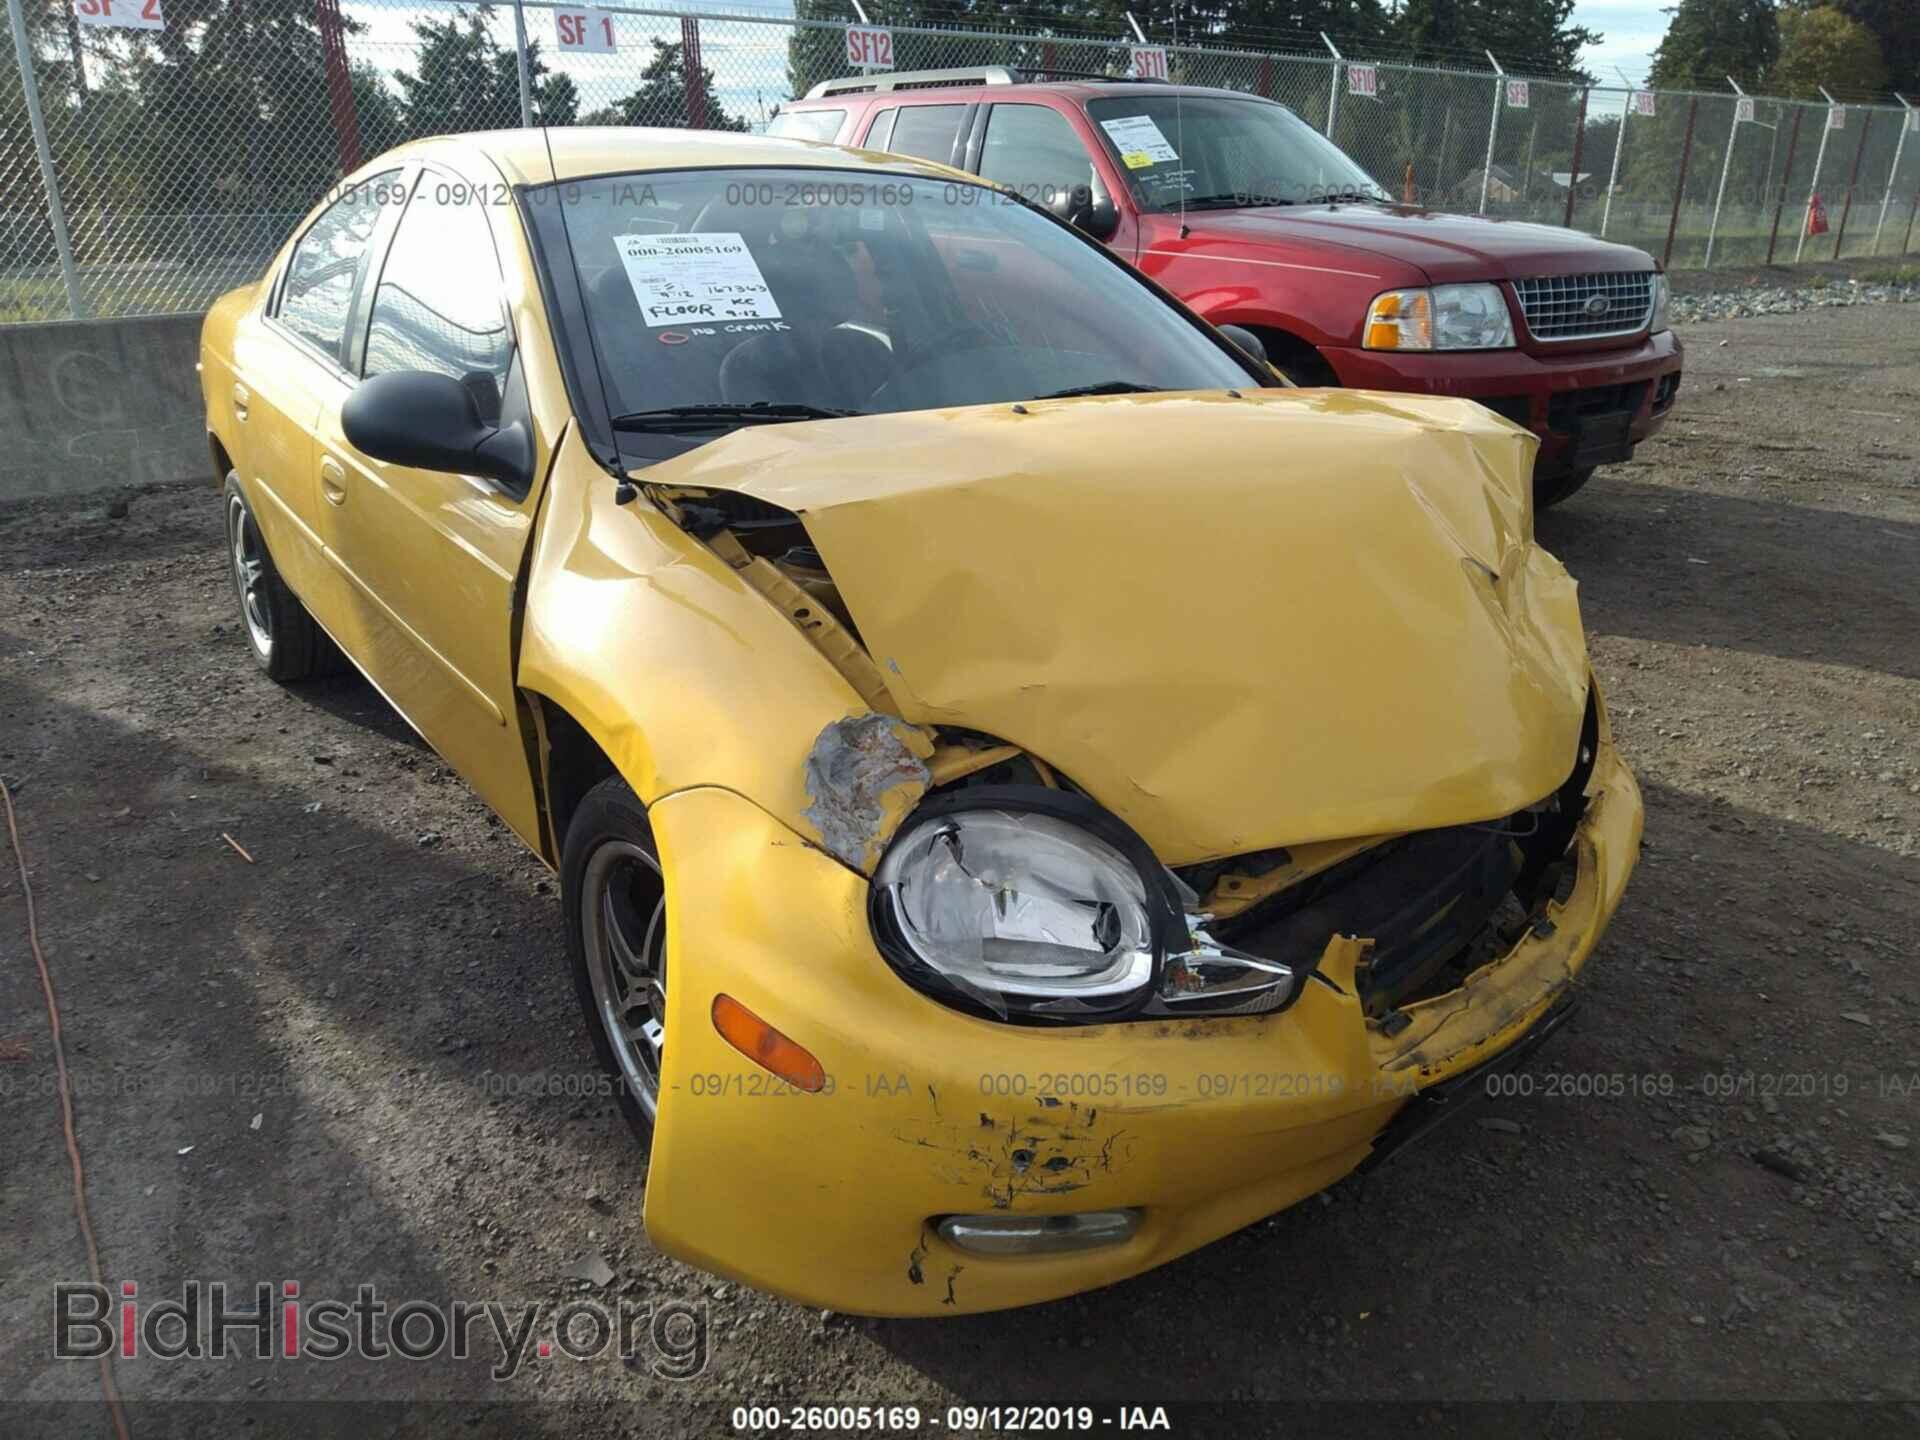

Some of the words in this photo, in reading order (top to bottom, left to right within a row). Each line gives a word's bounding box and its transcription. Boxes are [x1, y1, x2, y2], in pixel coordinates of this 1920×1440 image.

[558, 14, 586, 45] SF
[601, 17, 613, 47] 1
[848, 30, 893, 65] SF12
[1134, 50, 1165, 78] SF11
[1349, 67, 1376, 92] SF10
[628, 246, 742, 257] 000-26005169
[648, 304, 715, 318] FLOOR
